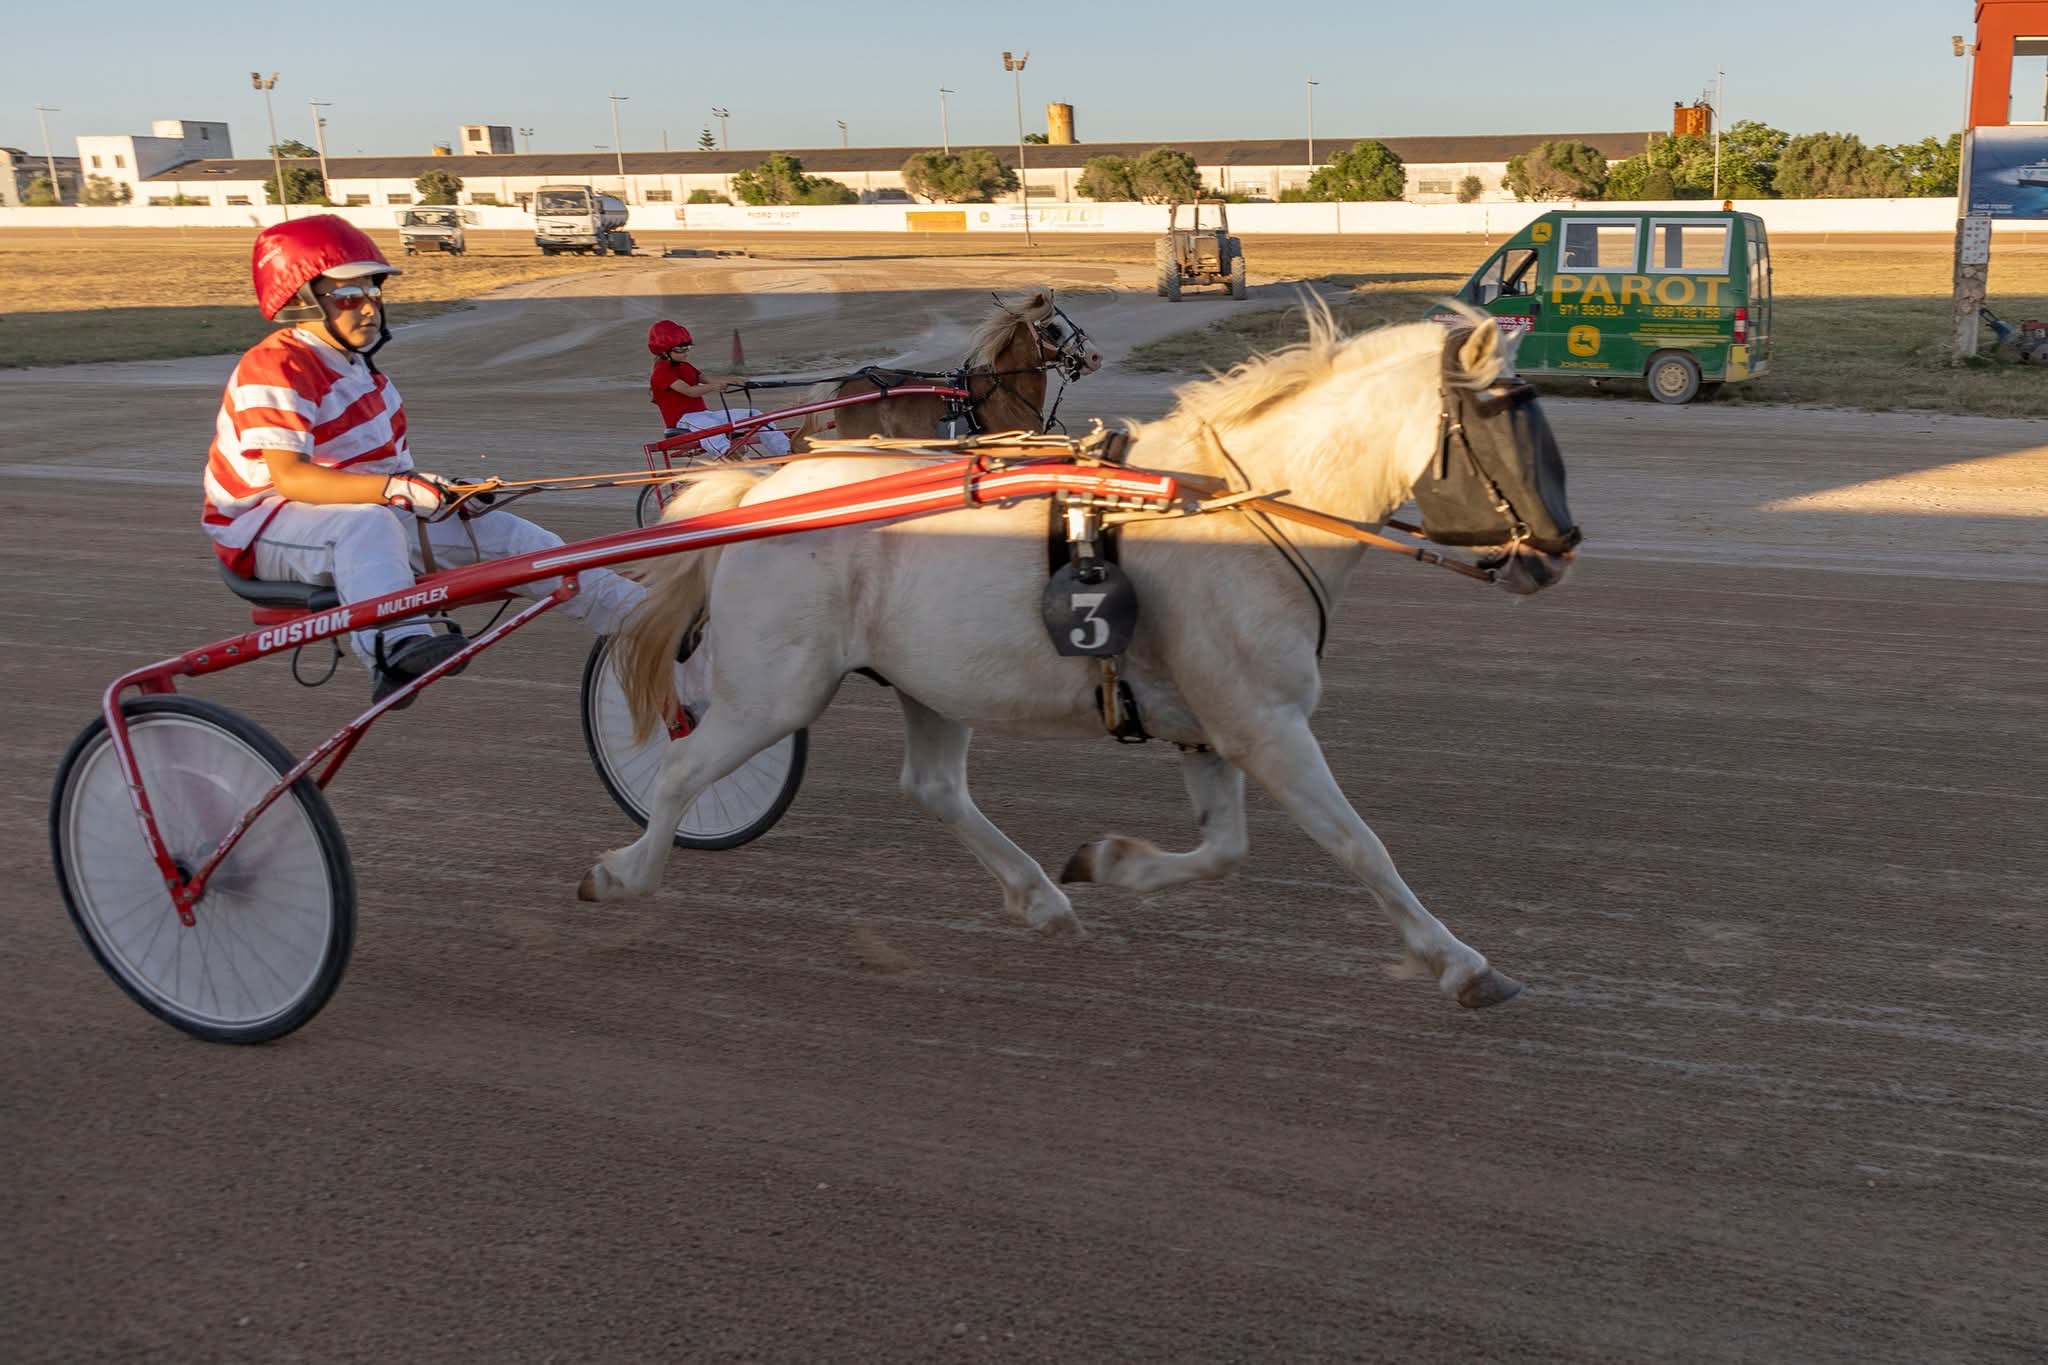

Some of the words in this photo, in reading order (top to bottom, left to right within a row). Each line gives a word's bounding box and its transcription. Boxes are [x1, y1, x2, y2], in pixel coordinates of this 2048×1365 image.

[1551, 274, 1730, 305] PAROT
[257, 609, 353, 652] CUSTOM
[376, 586, 449, 617] MULTIFLEX
[1069, 592, 1110, 649] 3
